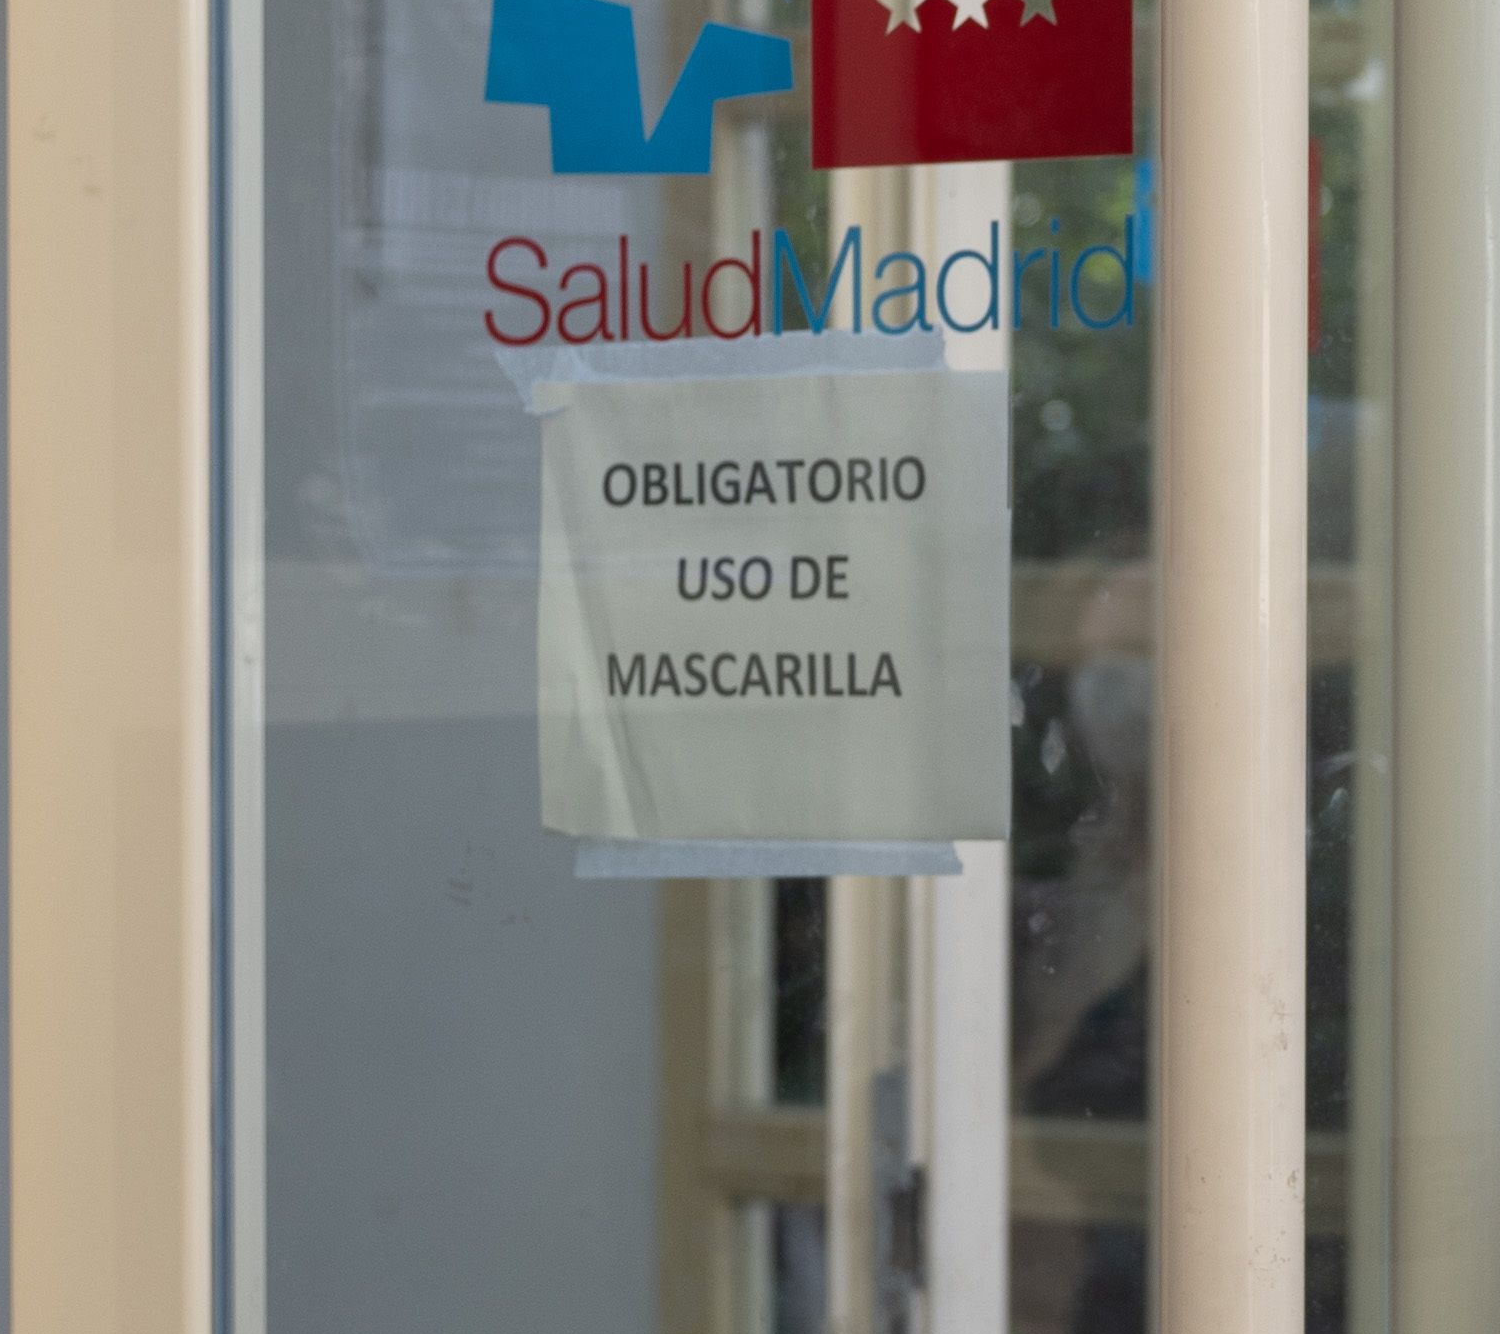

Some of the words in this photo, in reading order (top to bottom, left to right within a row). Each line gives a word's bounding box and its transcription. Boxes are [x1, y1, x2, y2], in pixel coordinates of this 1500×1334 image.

[602, 456, 927, 507] OBLIGATORIO
[677, 556, 773, 600] USO
[790, 556, 850, 600] DE
[606, 652, 902, 698] MASCARILLA
